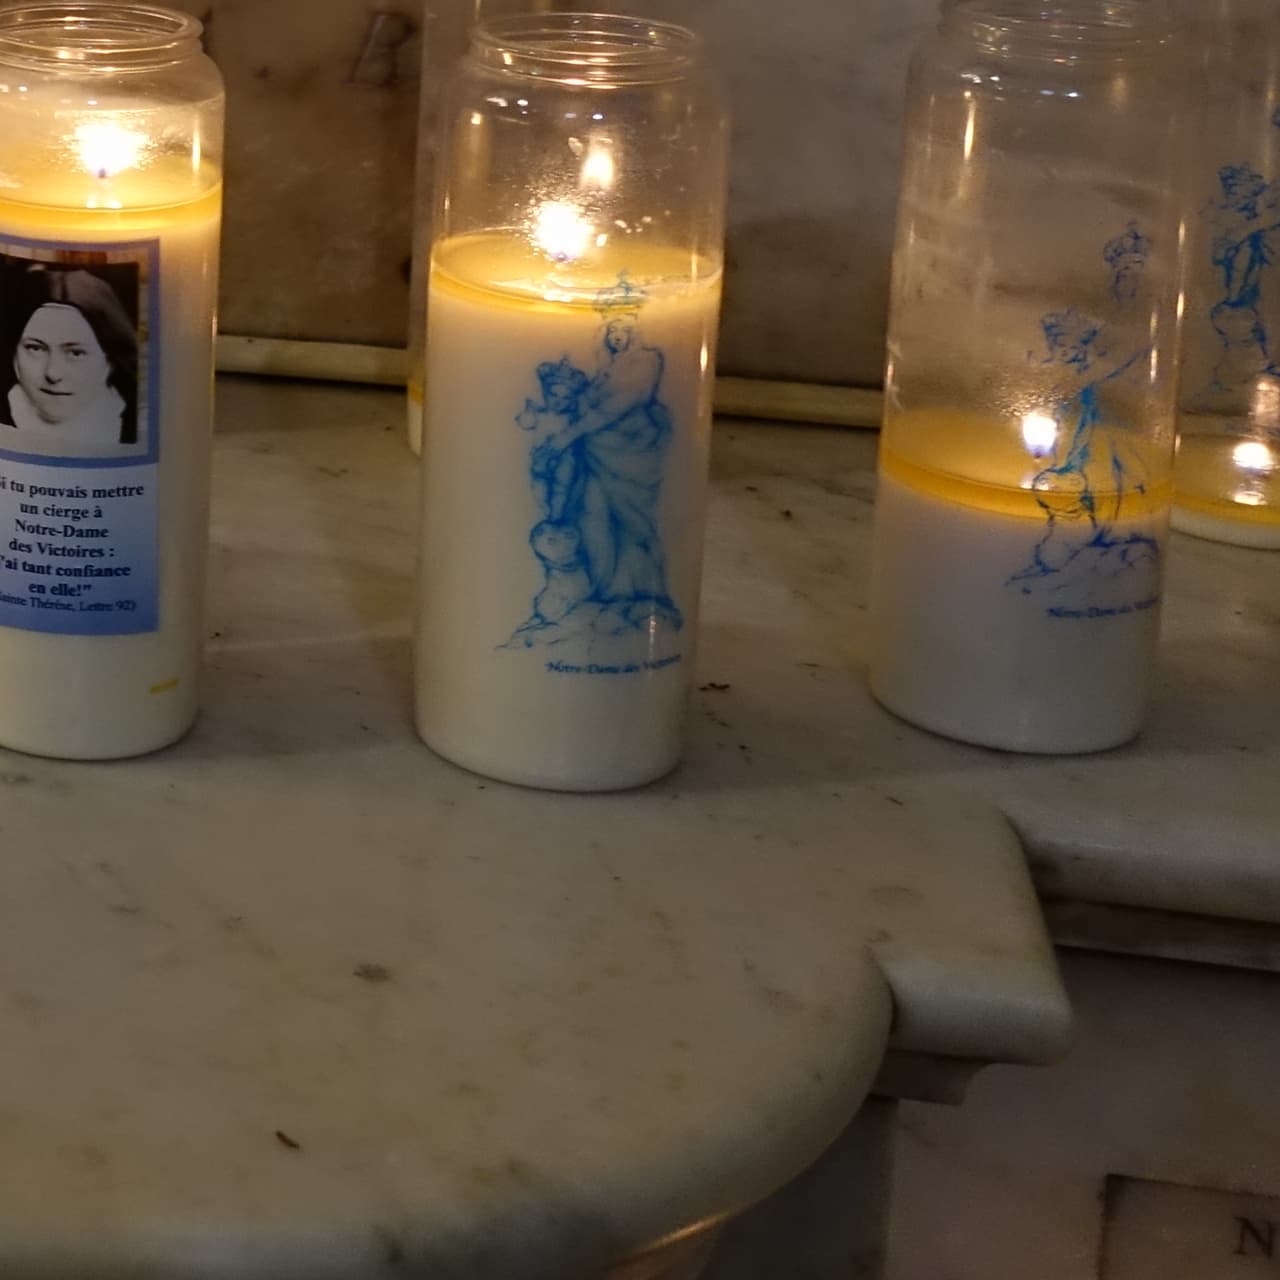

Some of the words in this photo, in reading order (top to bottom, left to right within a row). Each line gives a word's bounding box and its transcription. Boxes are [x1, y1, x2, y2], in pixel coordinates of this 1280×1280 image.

[10, 480, 24, 494] tu
[29, 484, 87, 499] pouvais
[92, 485, 145, 498] mettre
[20, 502, 39, 515] un
[43, 505, 89, 522] cierge
[93, 505, 103, 518] à
[15, 518, 109, 538] Notre-Dame
[9, 538, 32, 554] des
[36, 541, 104, 557] Victoires
[22, 561, 52, 575] tant
[55, 564, 131, 577] confiance
[28, 582, 46, 594] en
